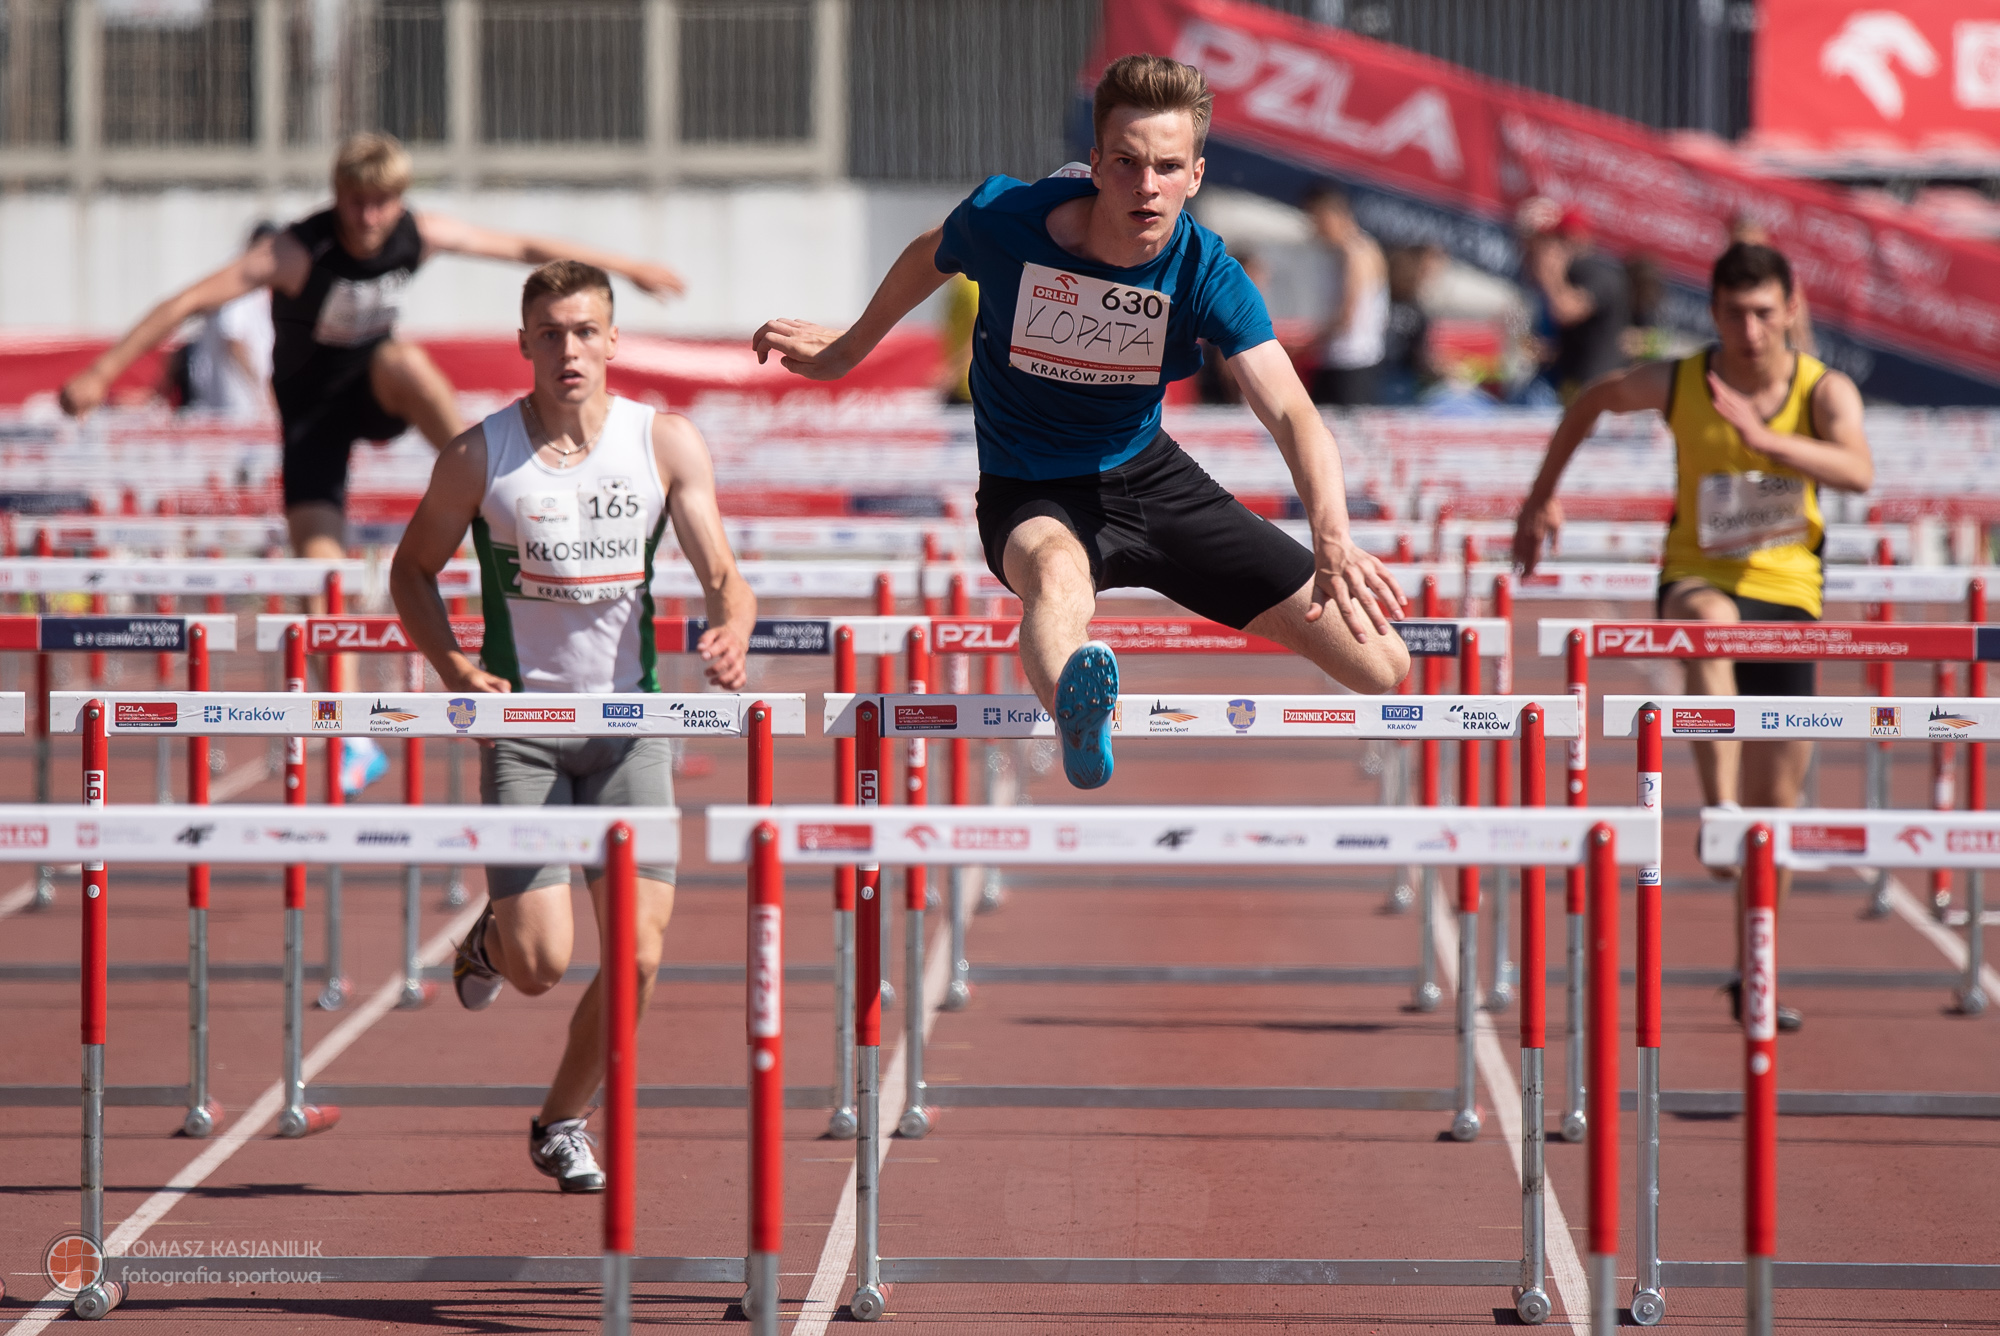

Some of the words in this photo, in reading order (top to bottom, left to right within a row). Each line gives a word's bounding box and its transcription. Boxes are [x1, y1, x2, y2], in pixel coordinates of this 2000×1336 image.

[1173, 17, 1463, 180] PZLA
[1035, 287, 1077, 305] ORLEN
[1101, 287, 1163, 319] 630
[1031, 361, 1097, 383] KRAKÓW
[1100, 373, 1136, 383] 2019
[588, 495, 640, 520] 165
[525, 537, 638, 562] KŁOSIŃSKI
[537, 586, 594, 601] KRAKÓW
[129, 622, 179, 635] KRAKÓW
[312, 623, 408, 647] PZLA
[773, 623, 824, 637] KRAKÓW
[1704, 629, 1802, 641] MISTRZOSTWA
[1804, 629, 1852, 641] POLSKI
[95, 631, 151, 646] CZERWCA
[153, 633, 179, 646] 2019
[749, 635, 796, 648] ZERWCA
[798, 636, 824, 649] 2019
[1598, 627, 1695, 652] PZLA
[228, 707, 285, 721] Kraków
[505, 710, 542, 721] DZIENNIK
[543, 710, 576, 721] POLSKI
[683, 710, 717, 718] RADIO
[1007, 708, 1051, 722] Krakó
[1285, 711, 1323, 722] DZIENNIK
[1323, 712, 1355, 722] POLSKI
[1463, 712, 1497, 720] RADIO
[1785, 713, 1843, 727] Kraków
[314, 721, 341, 729] MZLA
[607, 720, 638, 728] KRAKÓW
[683, 718, 731, 728] KRAKÓW
[1387, 722, 1417, 730] KRAKÓW
[1463, 720, 1511, 730] KRAKÓW
[1873, 727, 1899, 736] MZLA
